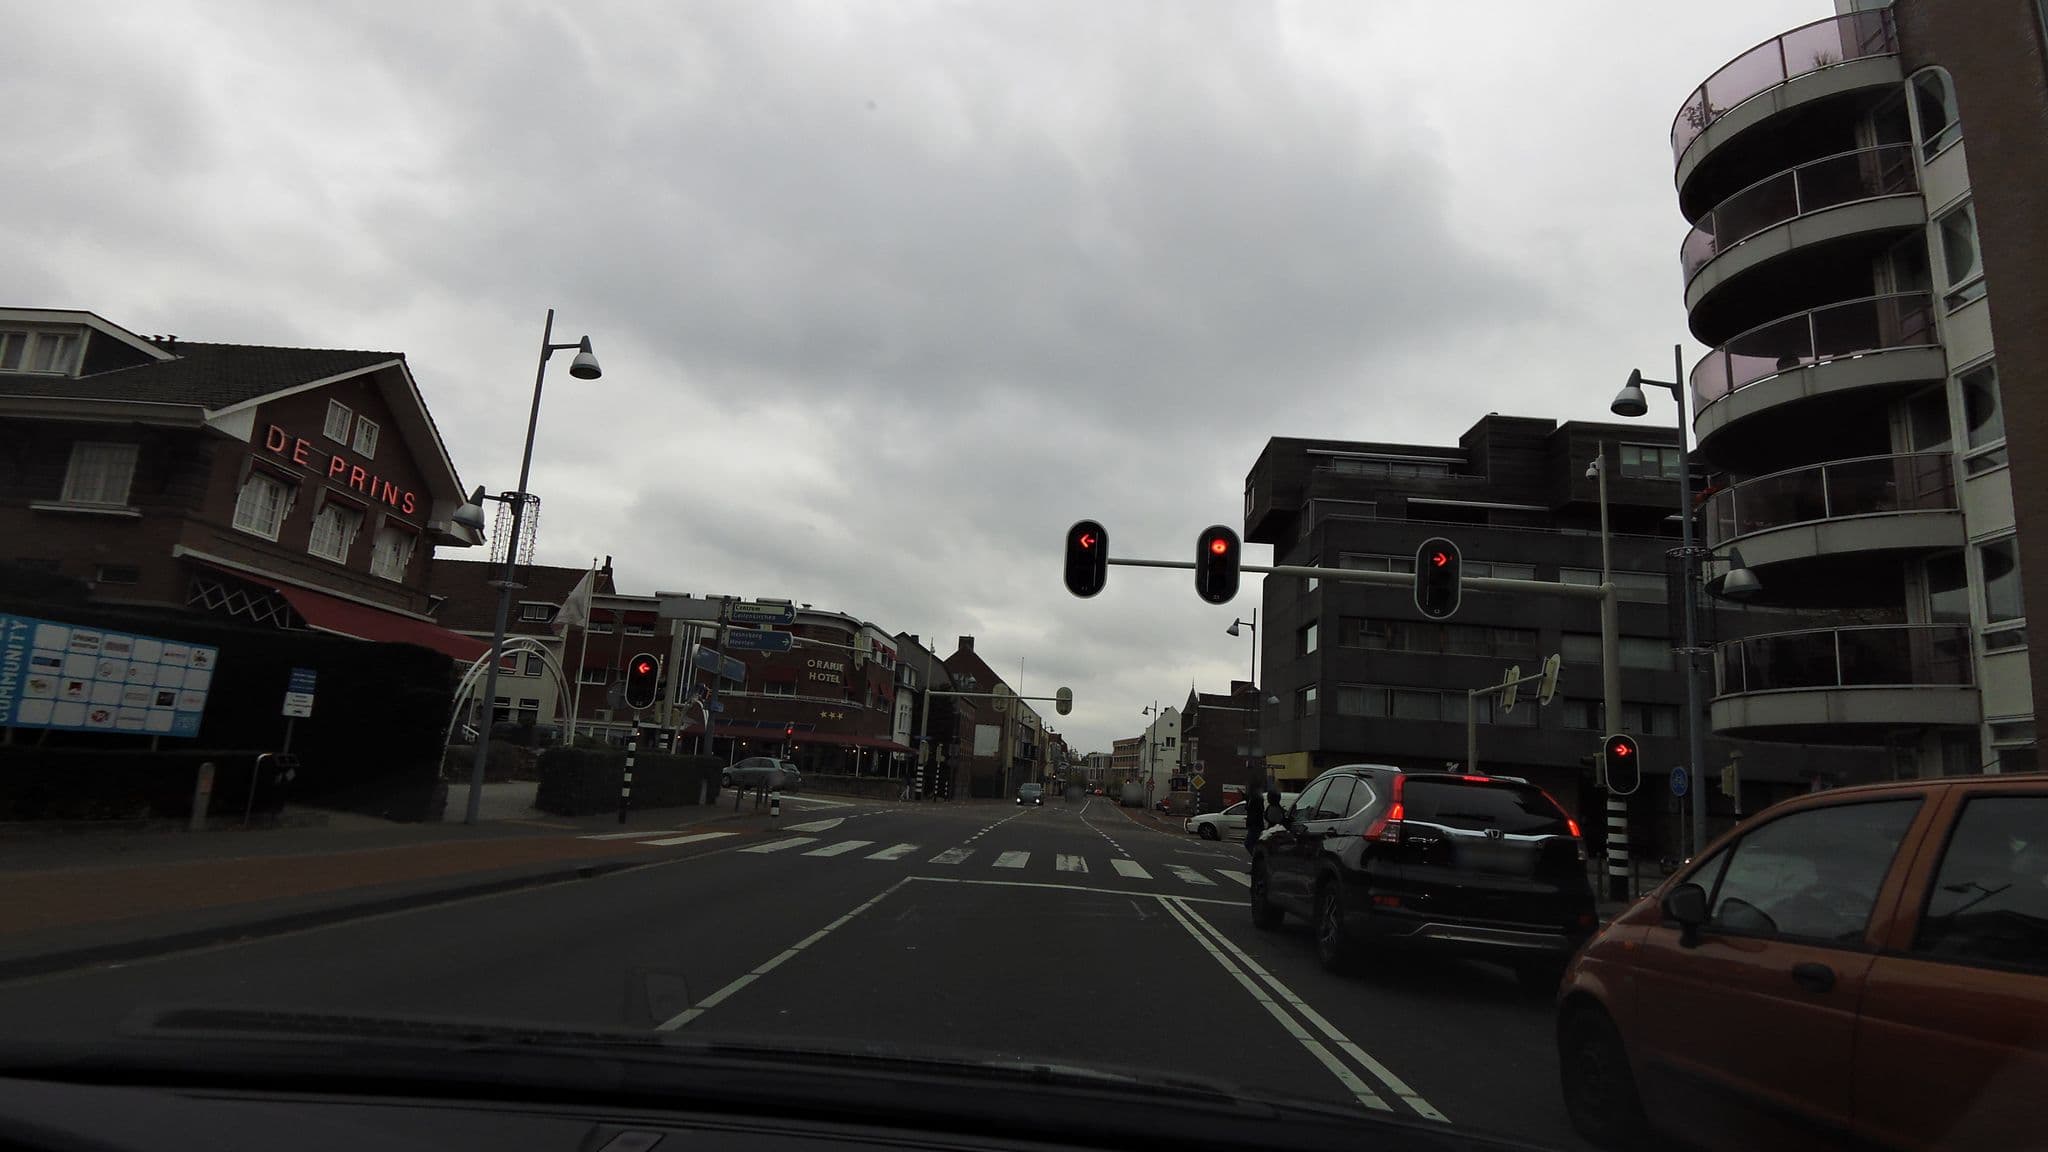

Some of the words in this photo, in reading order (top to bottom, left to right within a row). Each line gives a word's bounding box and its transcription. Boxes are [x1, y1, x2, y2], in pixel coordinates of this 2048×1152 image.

[266, 424, 310, 465] DE
[328, 455, 417, 514] PRINS
[807, 659, 844, 672] ORANJE
[809, 672, 841, 683] HOTEL
